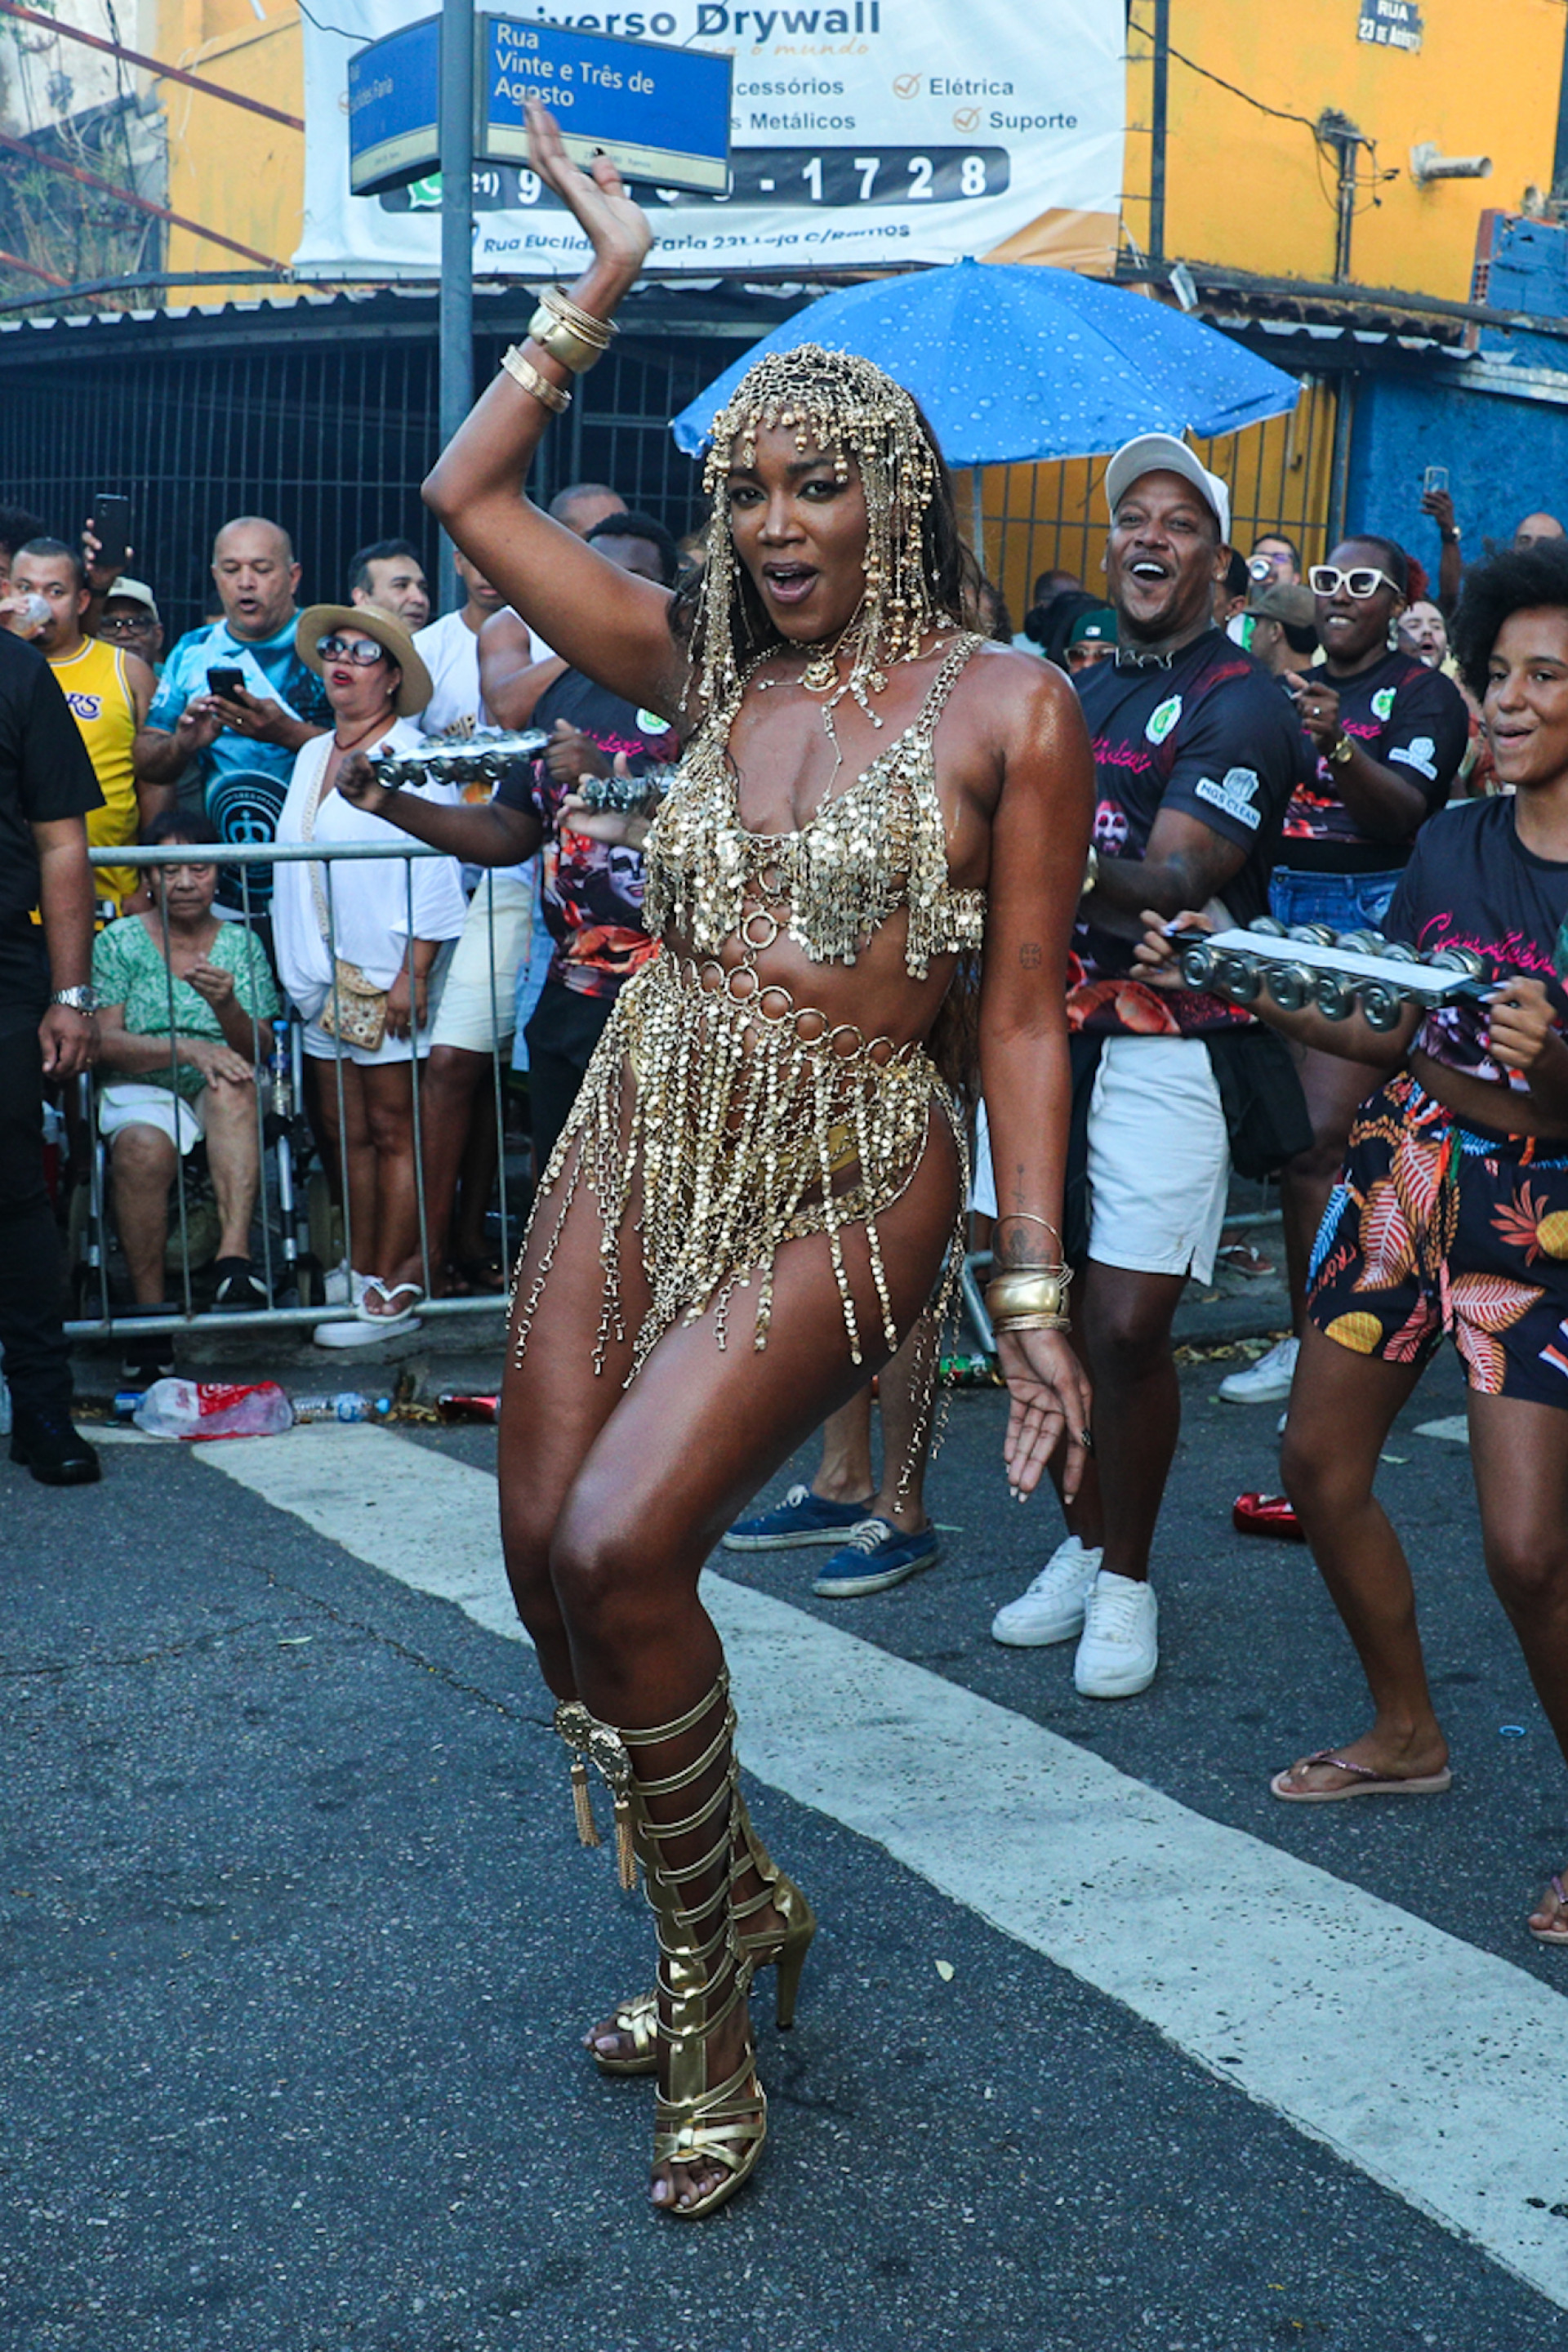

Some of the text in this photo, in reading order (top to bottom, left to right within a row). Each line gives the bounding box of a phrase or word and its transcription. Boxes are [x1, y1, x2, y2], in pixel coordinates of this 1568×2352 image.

[1377, 0, 1409, 21] RUA
[697, 2, 880, 43] Drywall
[1359, 17, 1376, 40] 23
[497, 23, 539, 49] Rua
[774, 37, 870, 56] mundo
[495, 50, 655, 94] Vinte e Três de
[494, 76, 574, 107] Agosto
[736, 78, 1014, 96] cessórios Elétrica
[750, 112, 856, 130] Metálicos
[989, 111, 1078, 132] Suporte
[471, 172, 500, 198] 21)
[483, 237, 520, 253] Rua
[525, 234, 592, 250] Euclid
